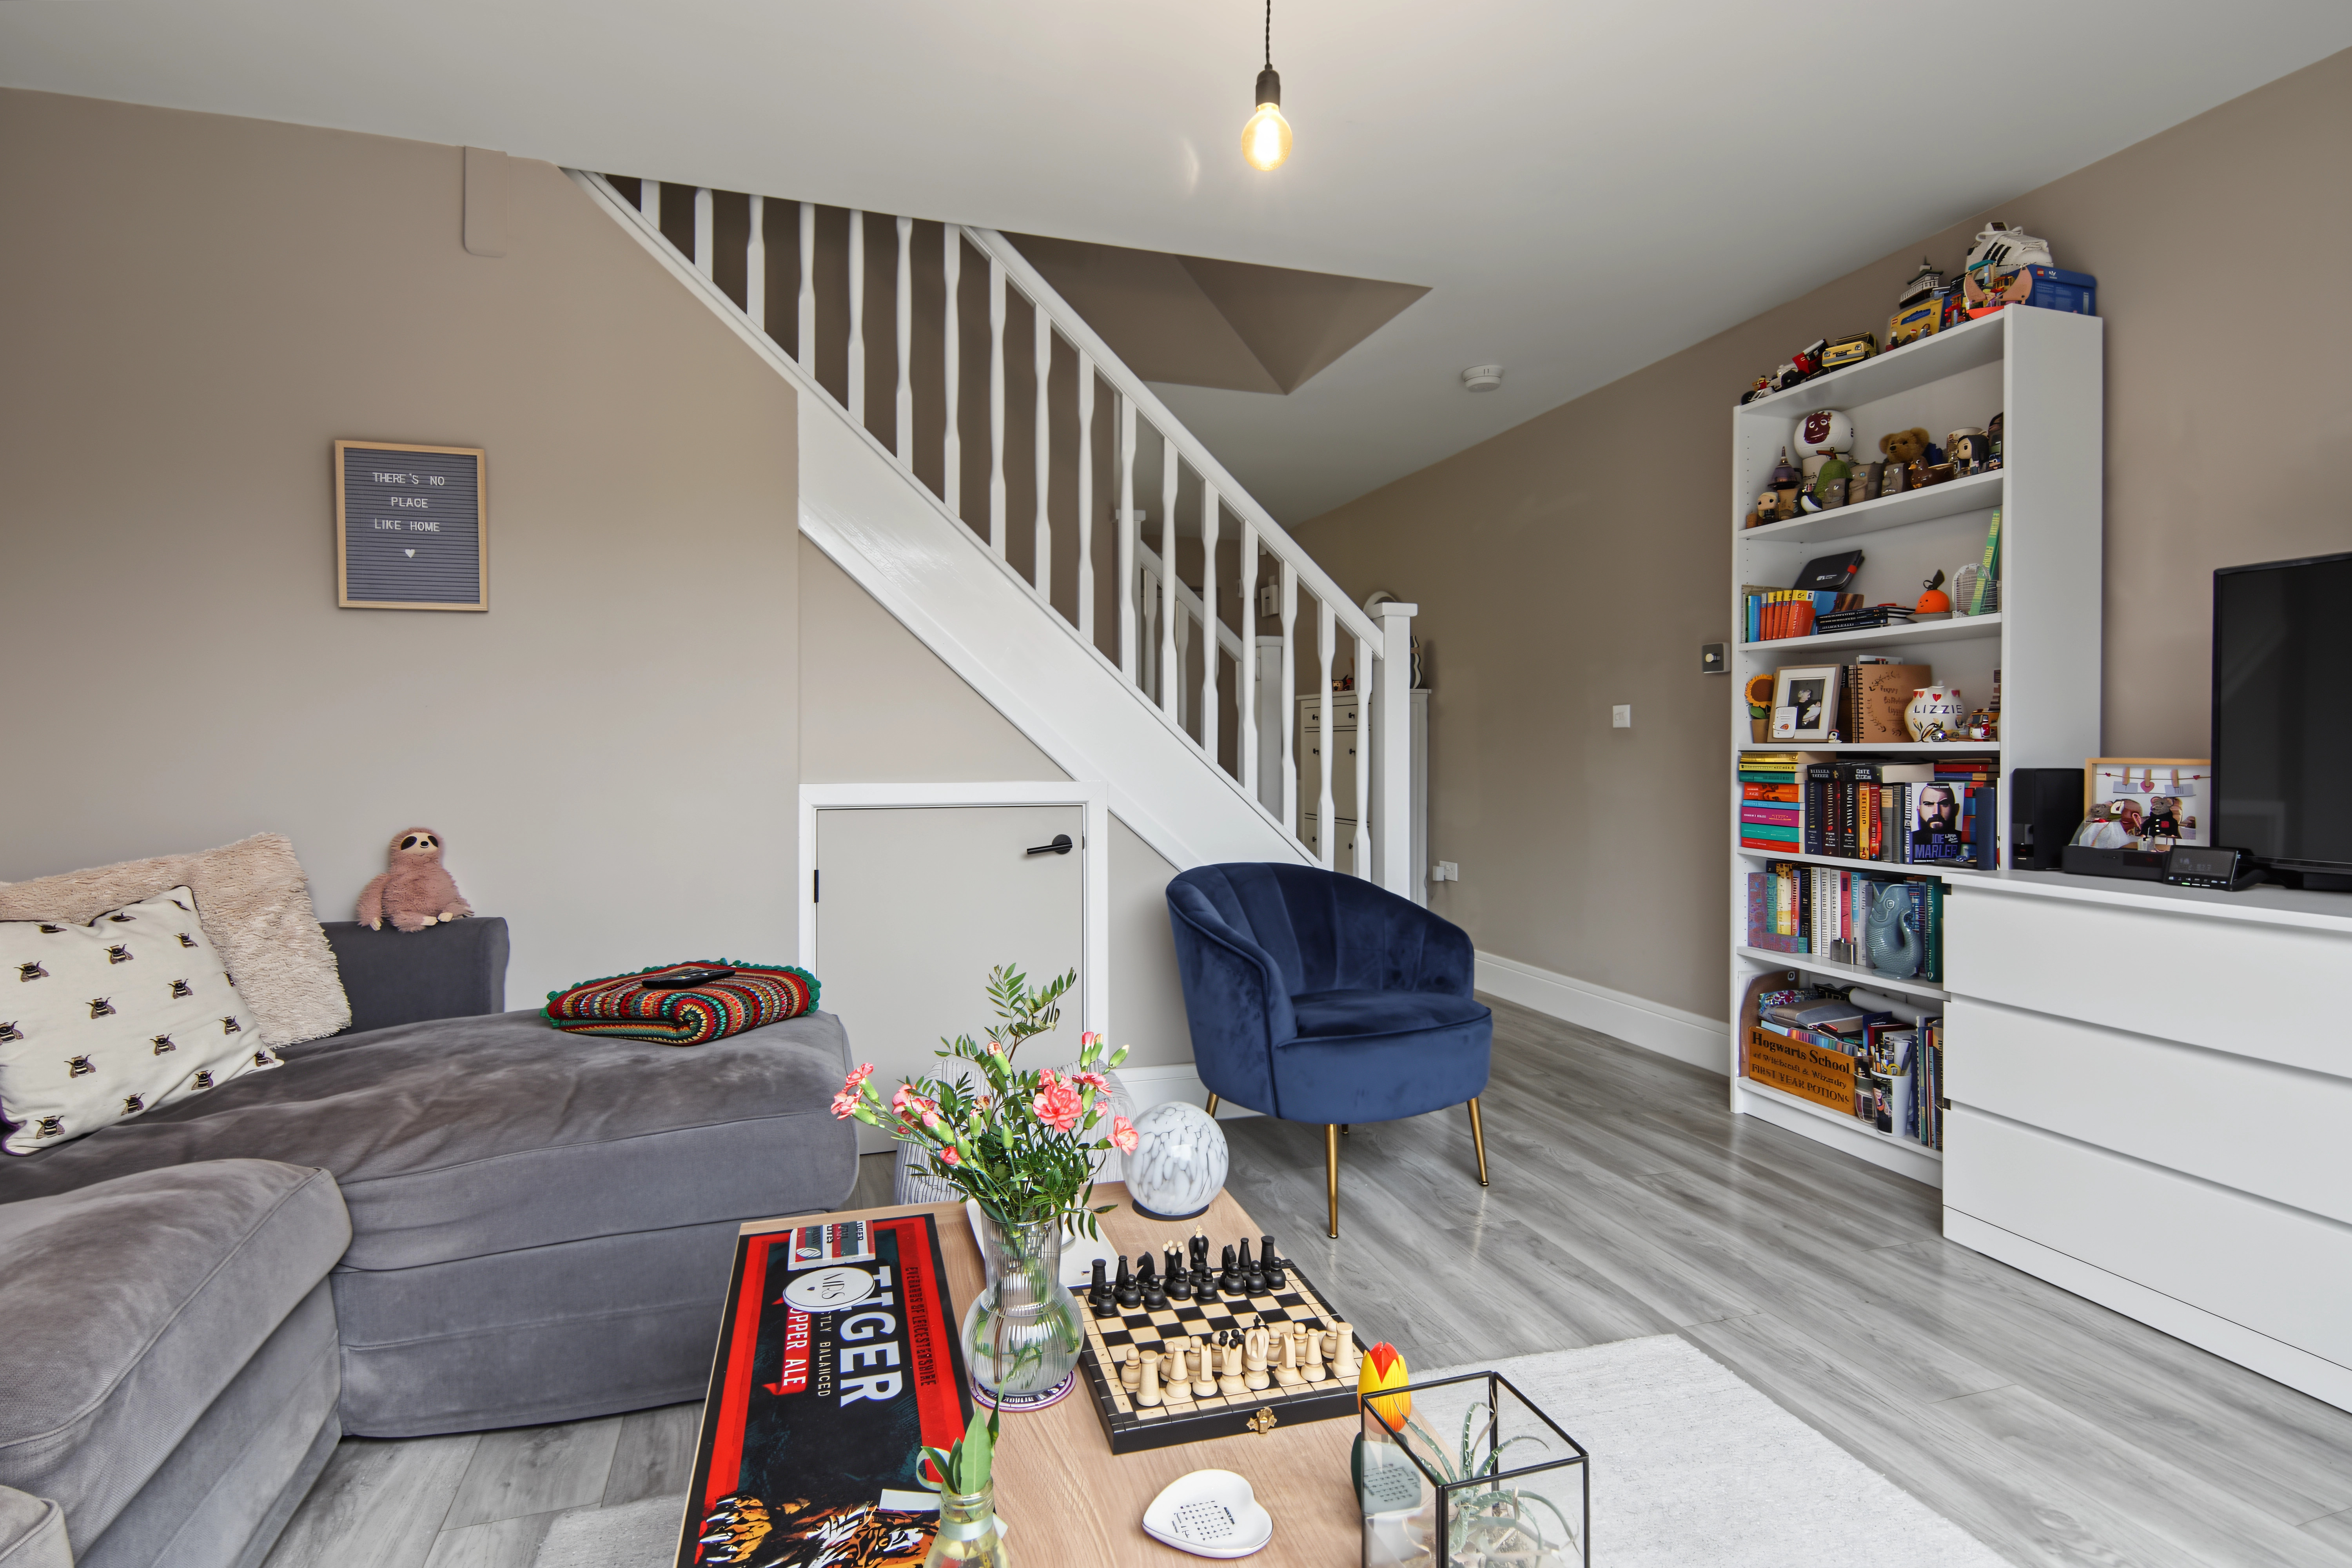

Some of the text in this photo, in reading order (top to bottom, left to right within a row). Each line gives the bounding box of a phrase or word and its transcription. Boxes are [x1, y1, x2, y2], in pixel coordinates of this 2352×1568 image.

[372, 472, 445, 486] THERE'S NO
[391, 496, 428, 508] PLACE
[374, 518, 440, 532] LIKE HOME
[1914, 704, 1963, 714] LIZZIE
[1751, 1032, 1850, 1074] Hogwarts School
[1807, 1082, 1850, 1104] POTIONS
[821, 1272, 846, 1299] MRS
[783, 1307, 809, 1386] OPPER ALE
[840, 1265, 903, 1408] TIGER
[817, 1341, 831, 1397] BALANCED
